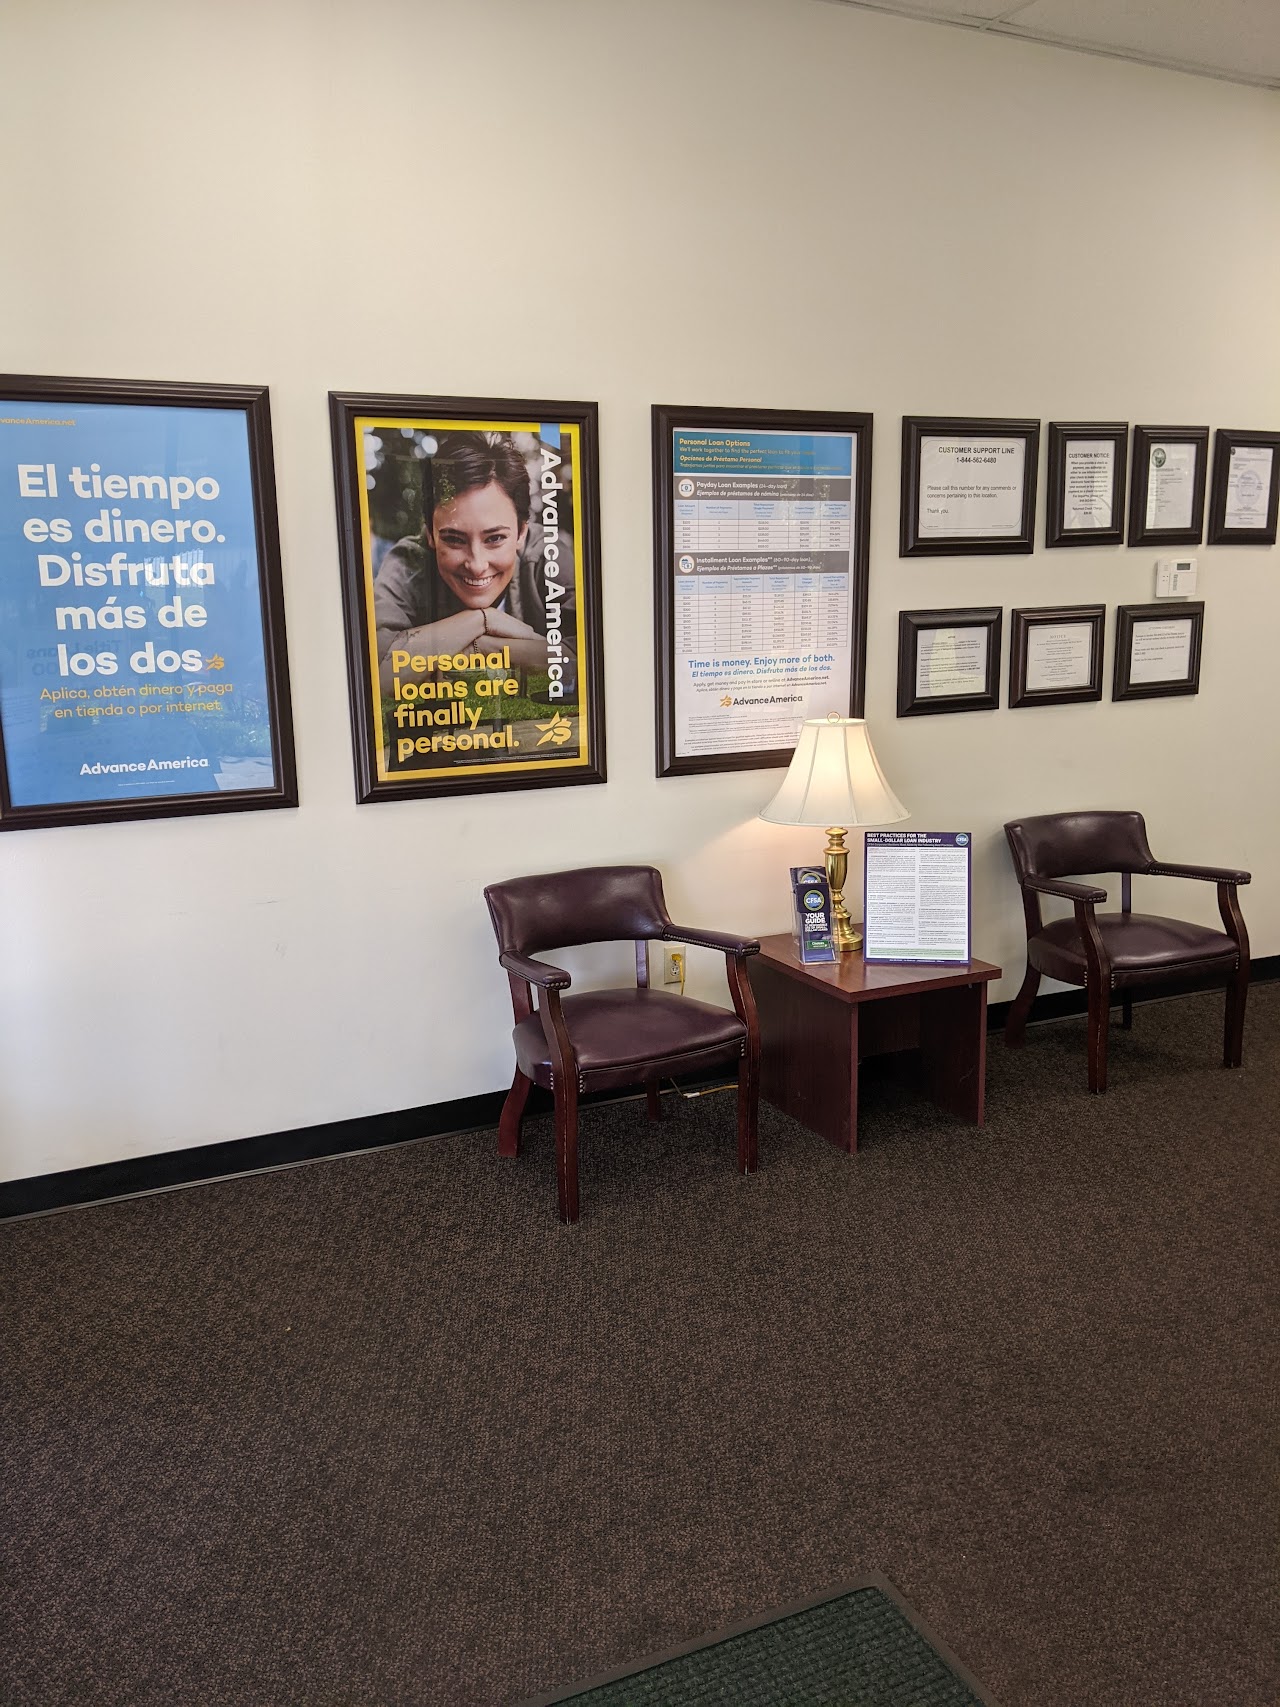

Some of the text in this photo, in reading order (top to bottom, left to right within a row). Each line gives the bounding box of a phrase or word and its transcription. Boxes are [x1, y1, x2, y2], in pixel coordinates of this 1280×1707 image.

[679, 438, 707, 446] Personal
[725, 439, 751, 447] Options
[938, 446, 972, 454] CUSTOMER
[17, 463, 220, 510] El tiempo
[696, 481, 718, 489] Payday
[23, 508, 226, 543] es dinero.
[37, 552, 215, 587] Disfruta
[540, 448, 570, 699] AdvanceAmerica
[55, 595, 208, 630] más de
[57, 643, 119, 677] los
[129, 641, 203, 674] dos
[392, 645, 511, 673] Personal
[688, 660, 710, 668] Time
[713, 658, 720, 668] is
[722, 660, 752, 668] money.
[754, 656, 778, 666] Enjoy
[802, 654, 812, 663] of
[813, 654, 835, 662] both.
[700, 670, 723, 678] tiempo
[40, 682, 233, 703] Aplica, obtén dinero y paga
[393, 677, 519, 701] loans are
[733, 694, 803, 706] AdvanceAmerica
[54, 700, 224, 718] en tienda o por internet.
[394, 701, 482, 731] finally
[397, 725, 520, 763] personal.
[79, 756, 210, 775] AdvanceAmerica
